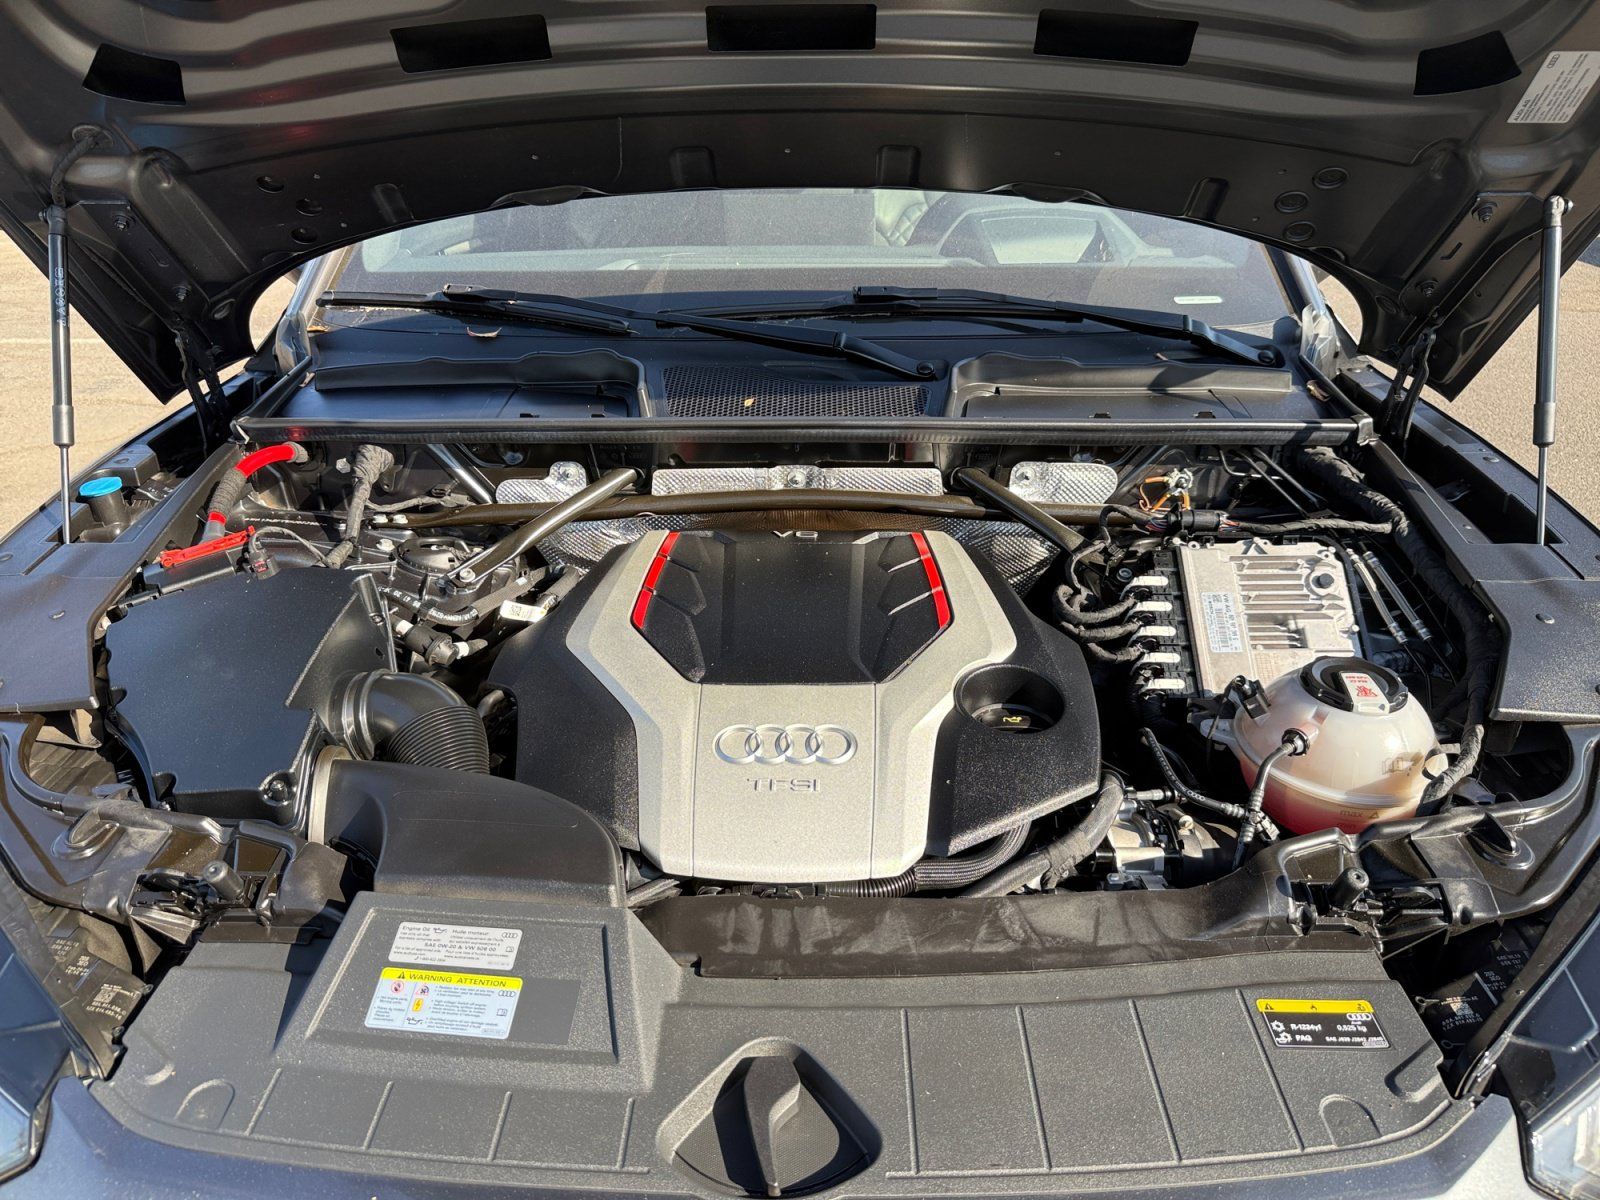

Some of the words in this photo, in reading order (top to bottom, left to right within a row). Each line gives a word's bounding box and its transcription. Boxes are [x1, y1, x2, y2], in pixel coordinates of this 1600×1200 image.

[746, 778, 821, 792] TFSI
[409, 973, 452, 983] WARNING
[457, 976, 507, 987] ATTENTION
[1295, 1034, 1313, 1042] PAG
